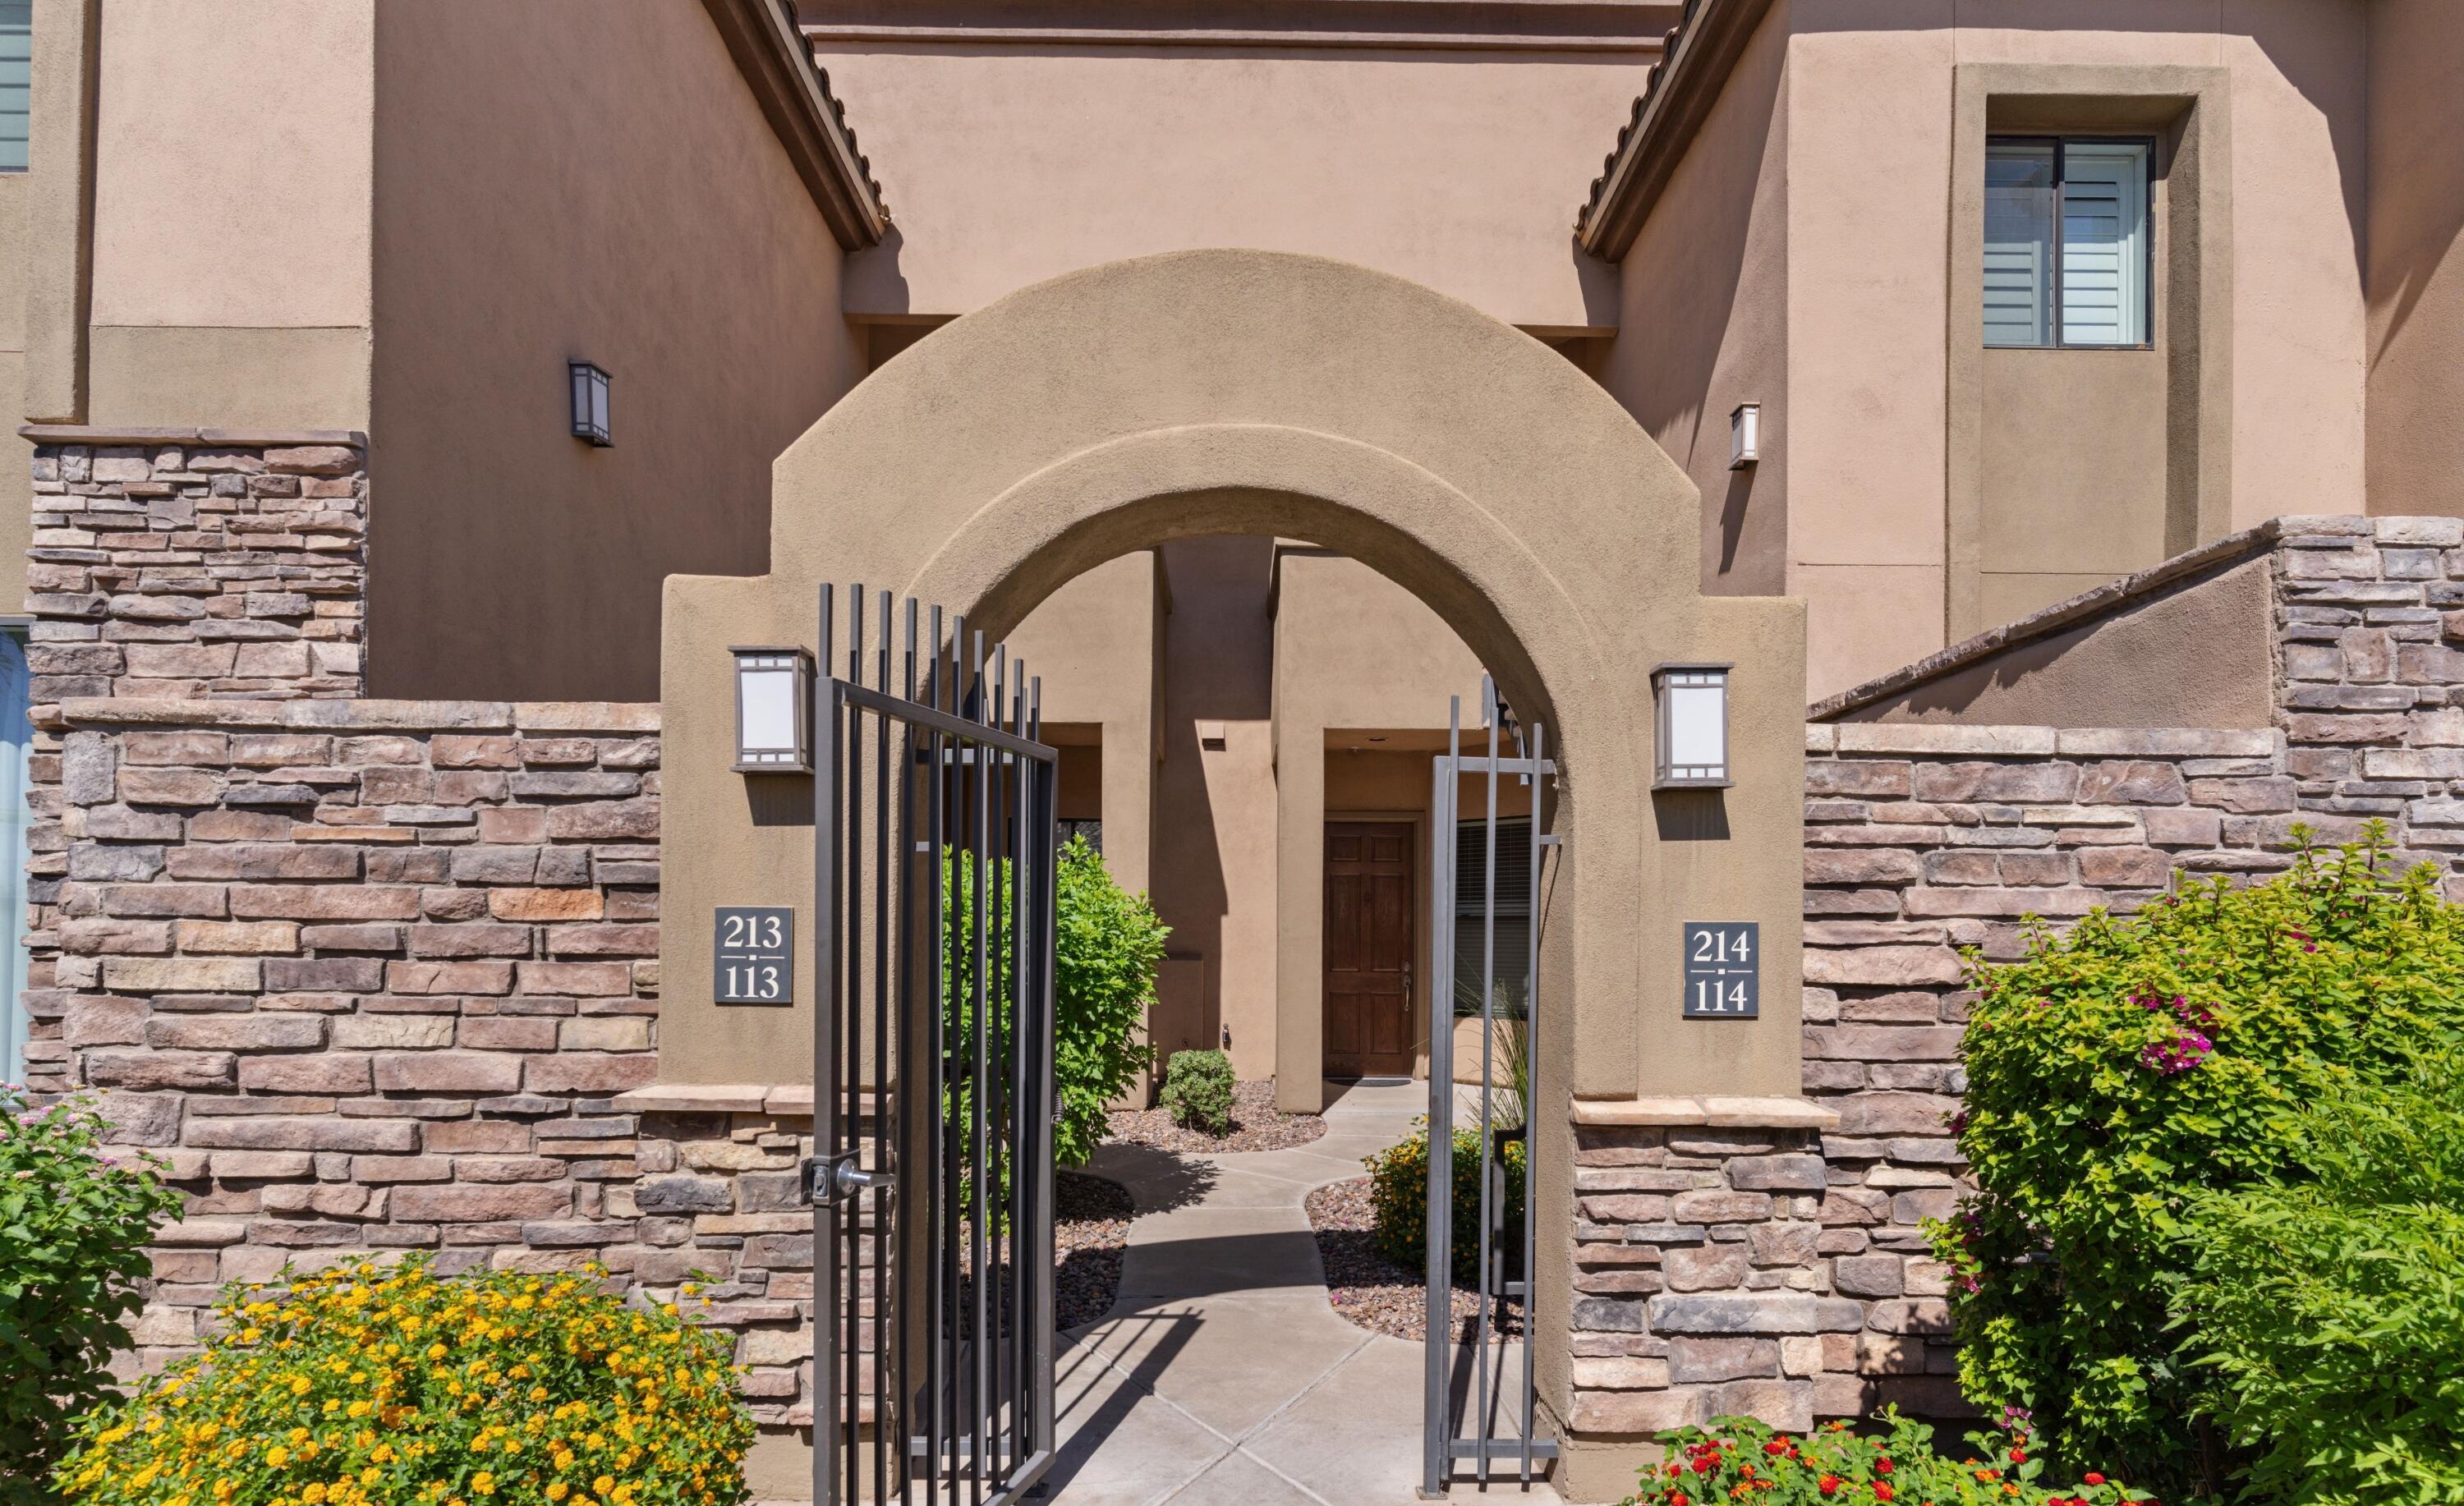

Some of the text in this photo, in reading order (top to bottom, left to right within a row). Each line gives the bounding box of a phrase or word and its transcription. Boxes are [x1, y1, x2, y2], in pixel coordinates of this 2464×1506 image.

[724, 916, 782, 948] 213
[1693, 930, 1750, 962] 214
[724, 966, 779, 998] 113
[1694, 980, 1748, 1011] 114
